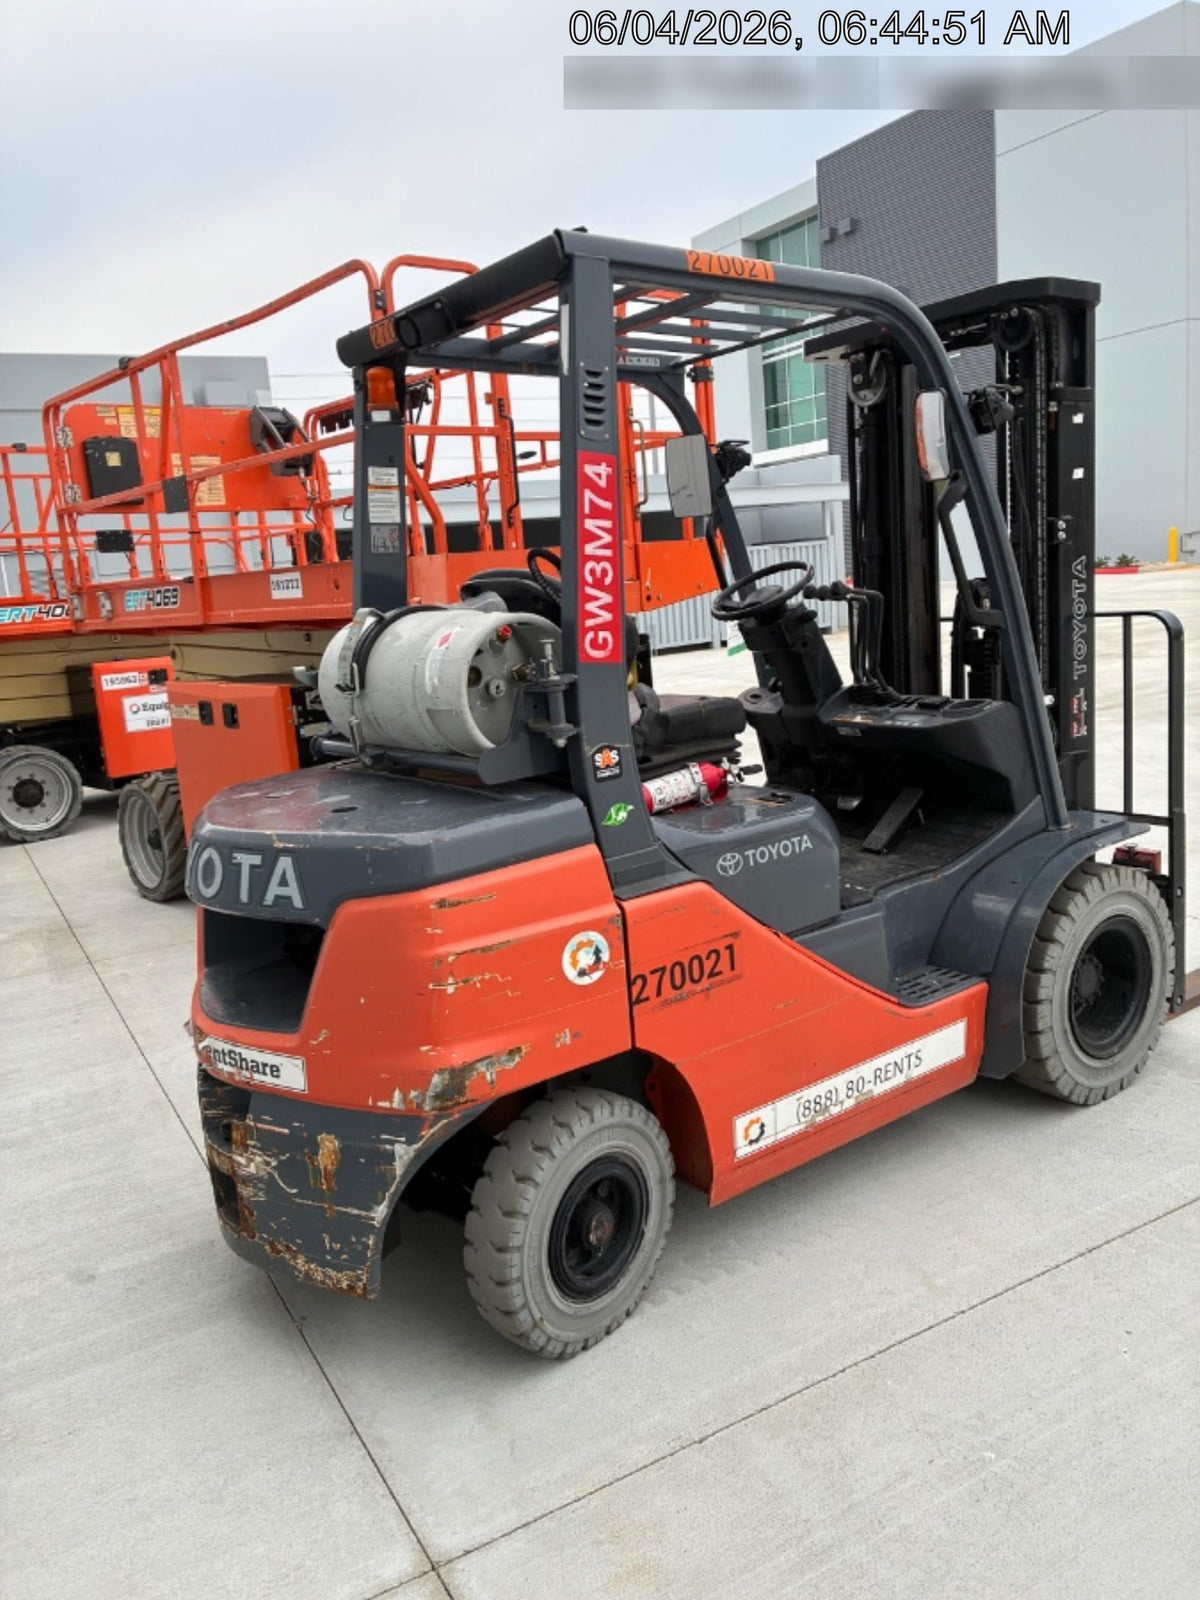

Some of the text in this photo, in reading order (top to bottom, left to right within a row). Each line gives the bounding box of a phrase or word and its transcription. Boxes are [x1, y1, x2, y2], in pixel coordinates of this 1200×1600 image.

[688, 250, 768, 280] 270021
[584, 461, 613, 659] GW3M74
[0, 604, 70, 623] ERT40
[1072, 556, 1087, 680] TOYOTA
[594, 748, 620, 768] SAS
[744, 834, 813, 867] TOYOTA
[630, 943, 736, 1007] 270021
[796, 1049, 923, 1124] (888) 80-RENTS
